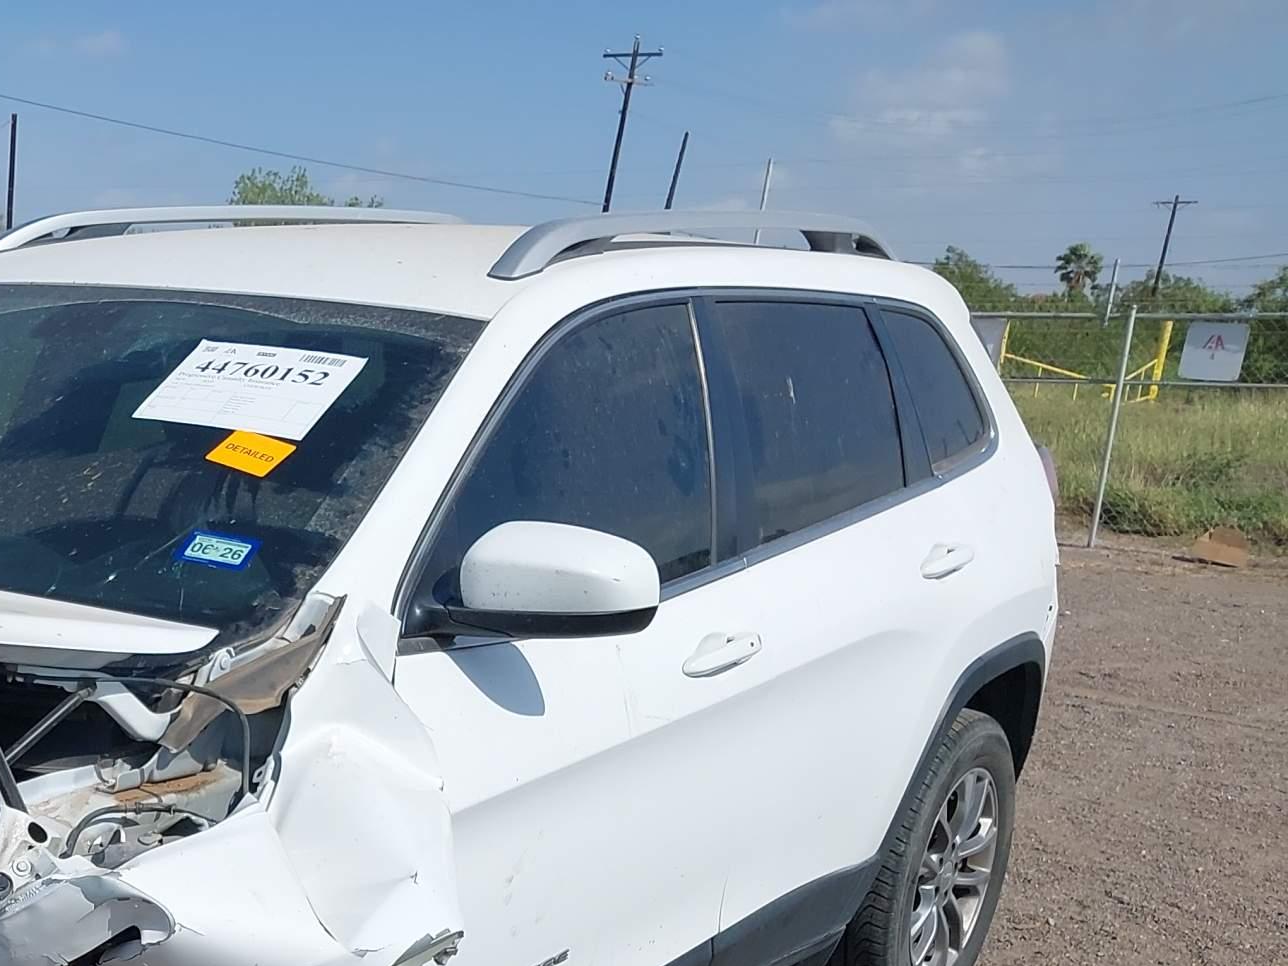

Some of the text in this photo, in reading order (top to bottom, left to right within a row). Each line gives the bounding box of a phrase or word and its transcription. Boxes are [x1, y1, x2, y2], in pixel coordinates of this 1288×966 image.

[195, 358, 331, 386] 44760152
[225, 443, 275, 463] DETAILED
[219, 547, 245, 561] 26
